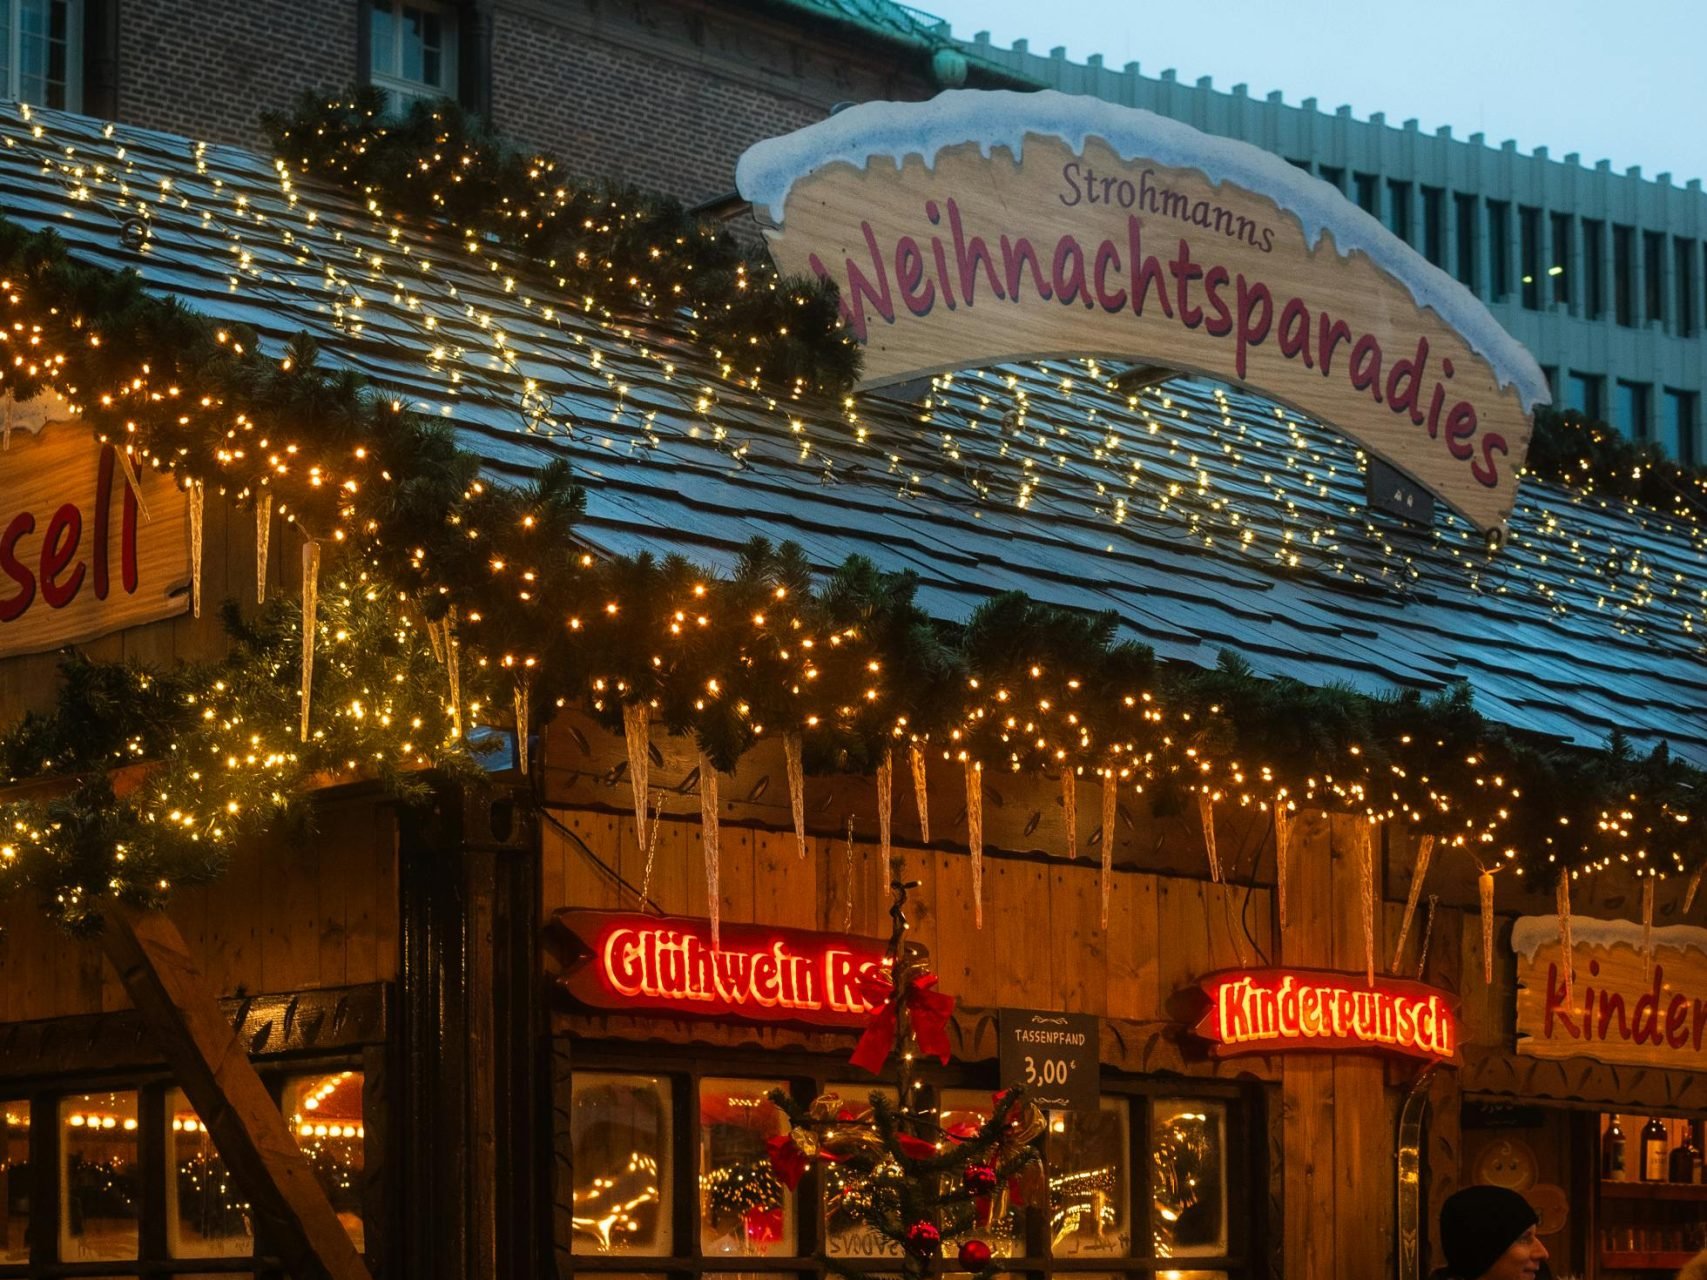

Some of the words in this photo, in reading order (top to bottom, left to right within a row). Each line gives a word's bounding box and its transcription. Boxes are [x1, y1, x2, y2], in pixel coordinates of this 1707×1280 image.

[1059, 163, 1275, 253] Strohmanns
[809, 197, 1508, 488] Weihnachtsparadies
[604, 928, 822, 1009] Glühwein
[1015, 1029, 1086, 1046] TASSENPFAND
[1219, 976, 1454, 1057] Kinderpunsch
